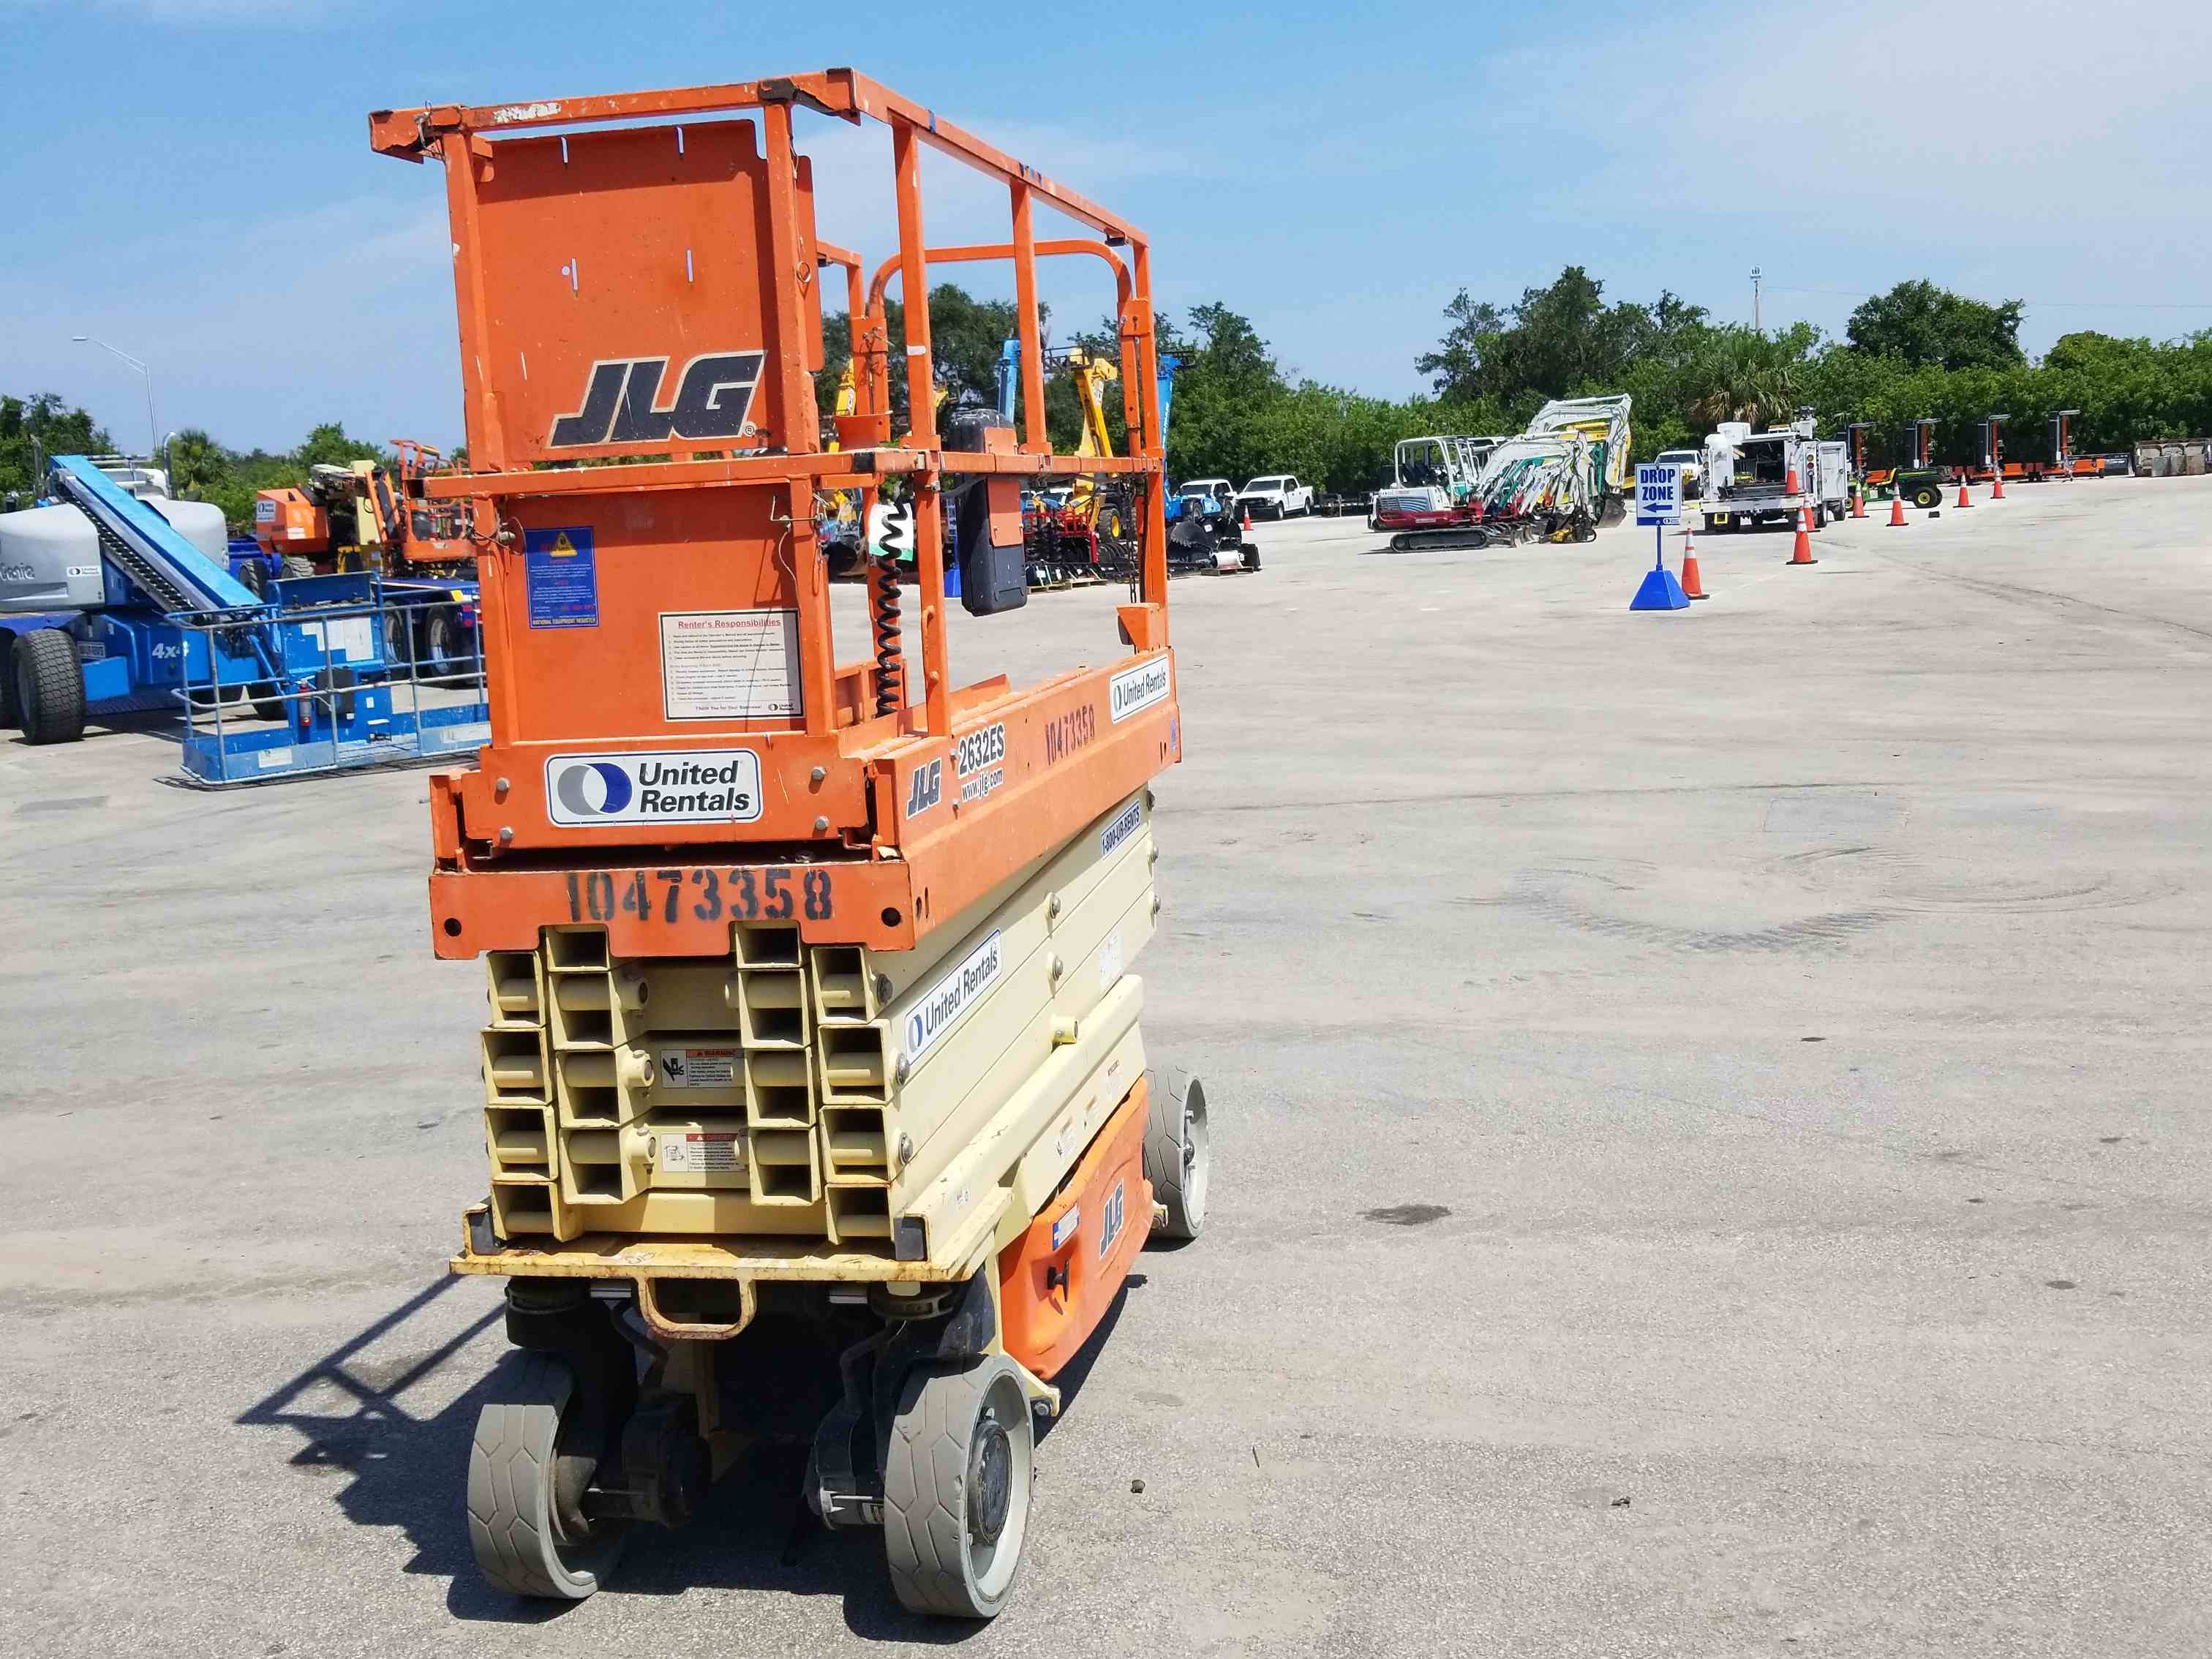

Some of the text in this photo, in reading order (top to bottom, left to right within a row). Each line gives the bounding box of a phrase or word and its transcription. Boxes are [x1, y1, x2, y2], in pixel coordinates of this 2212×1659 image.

[550, 354, 767, 448] JLG
[1640, 468, 1676, 484] DROP
[1641, 486, 1674, 501] ZONE
[678, 618, 781, 629] Renter's Responsibilities
[1123, 667, 1166, 707] United Rentals
[958, 724, 1005, 775] 2632ES
[639, 760, 739, 786] United
[906, 759, 941, 817] JLG
[962, 770, 1003, 799] www.jlg.com
[639, 787, 750, 813] Rentals
[567, 868, 832, 923] 10473358
[925, 949, 998, 1037] United Rentals
[1100, 1181, 1123, 1257] JLG
